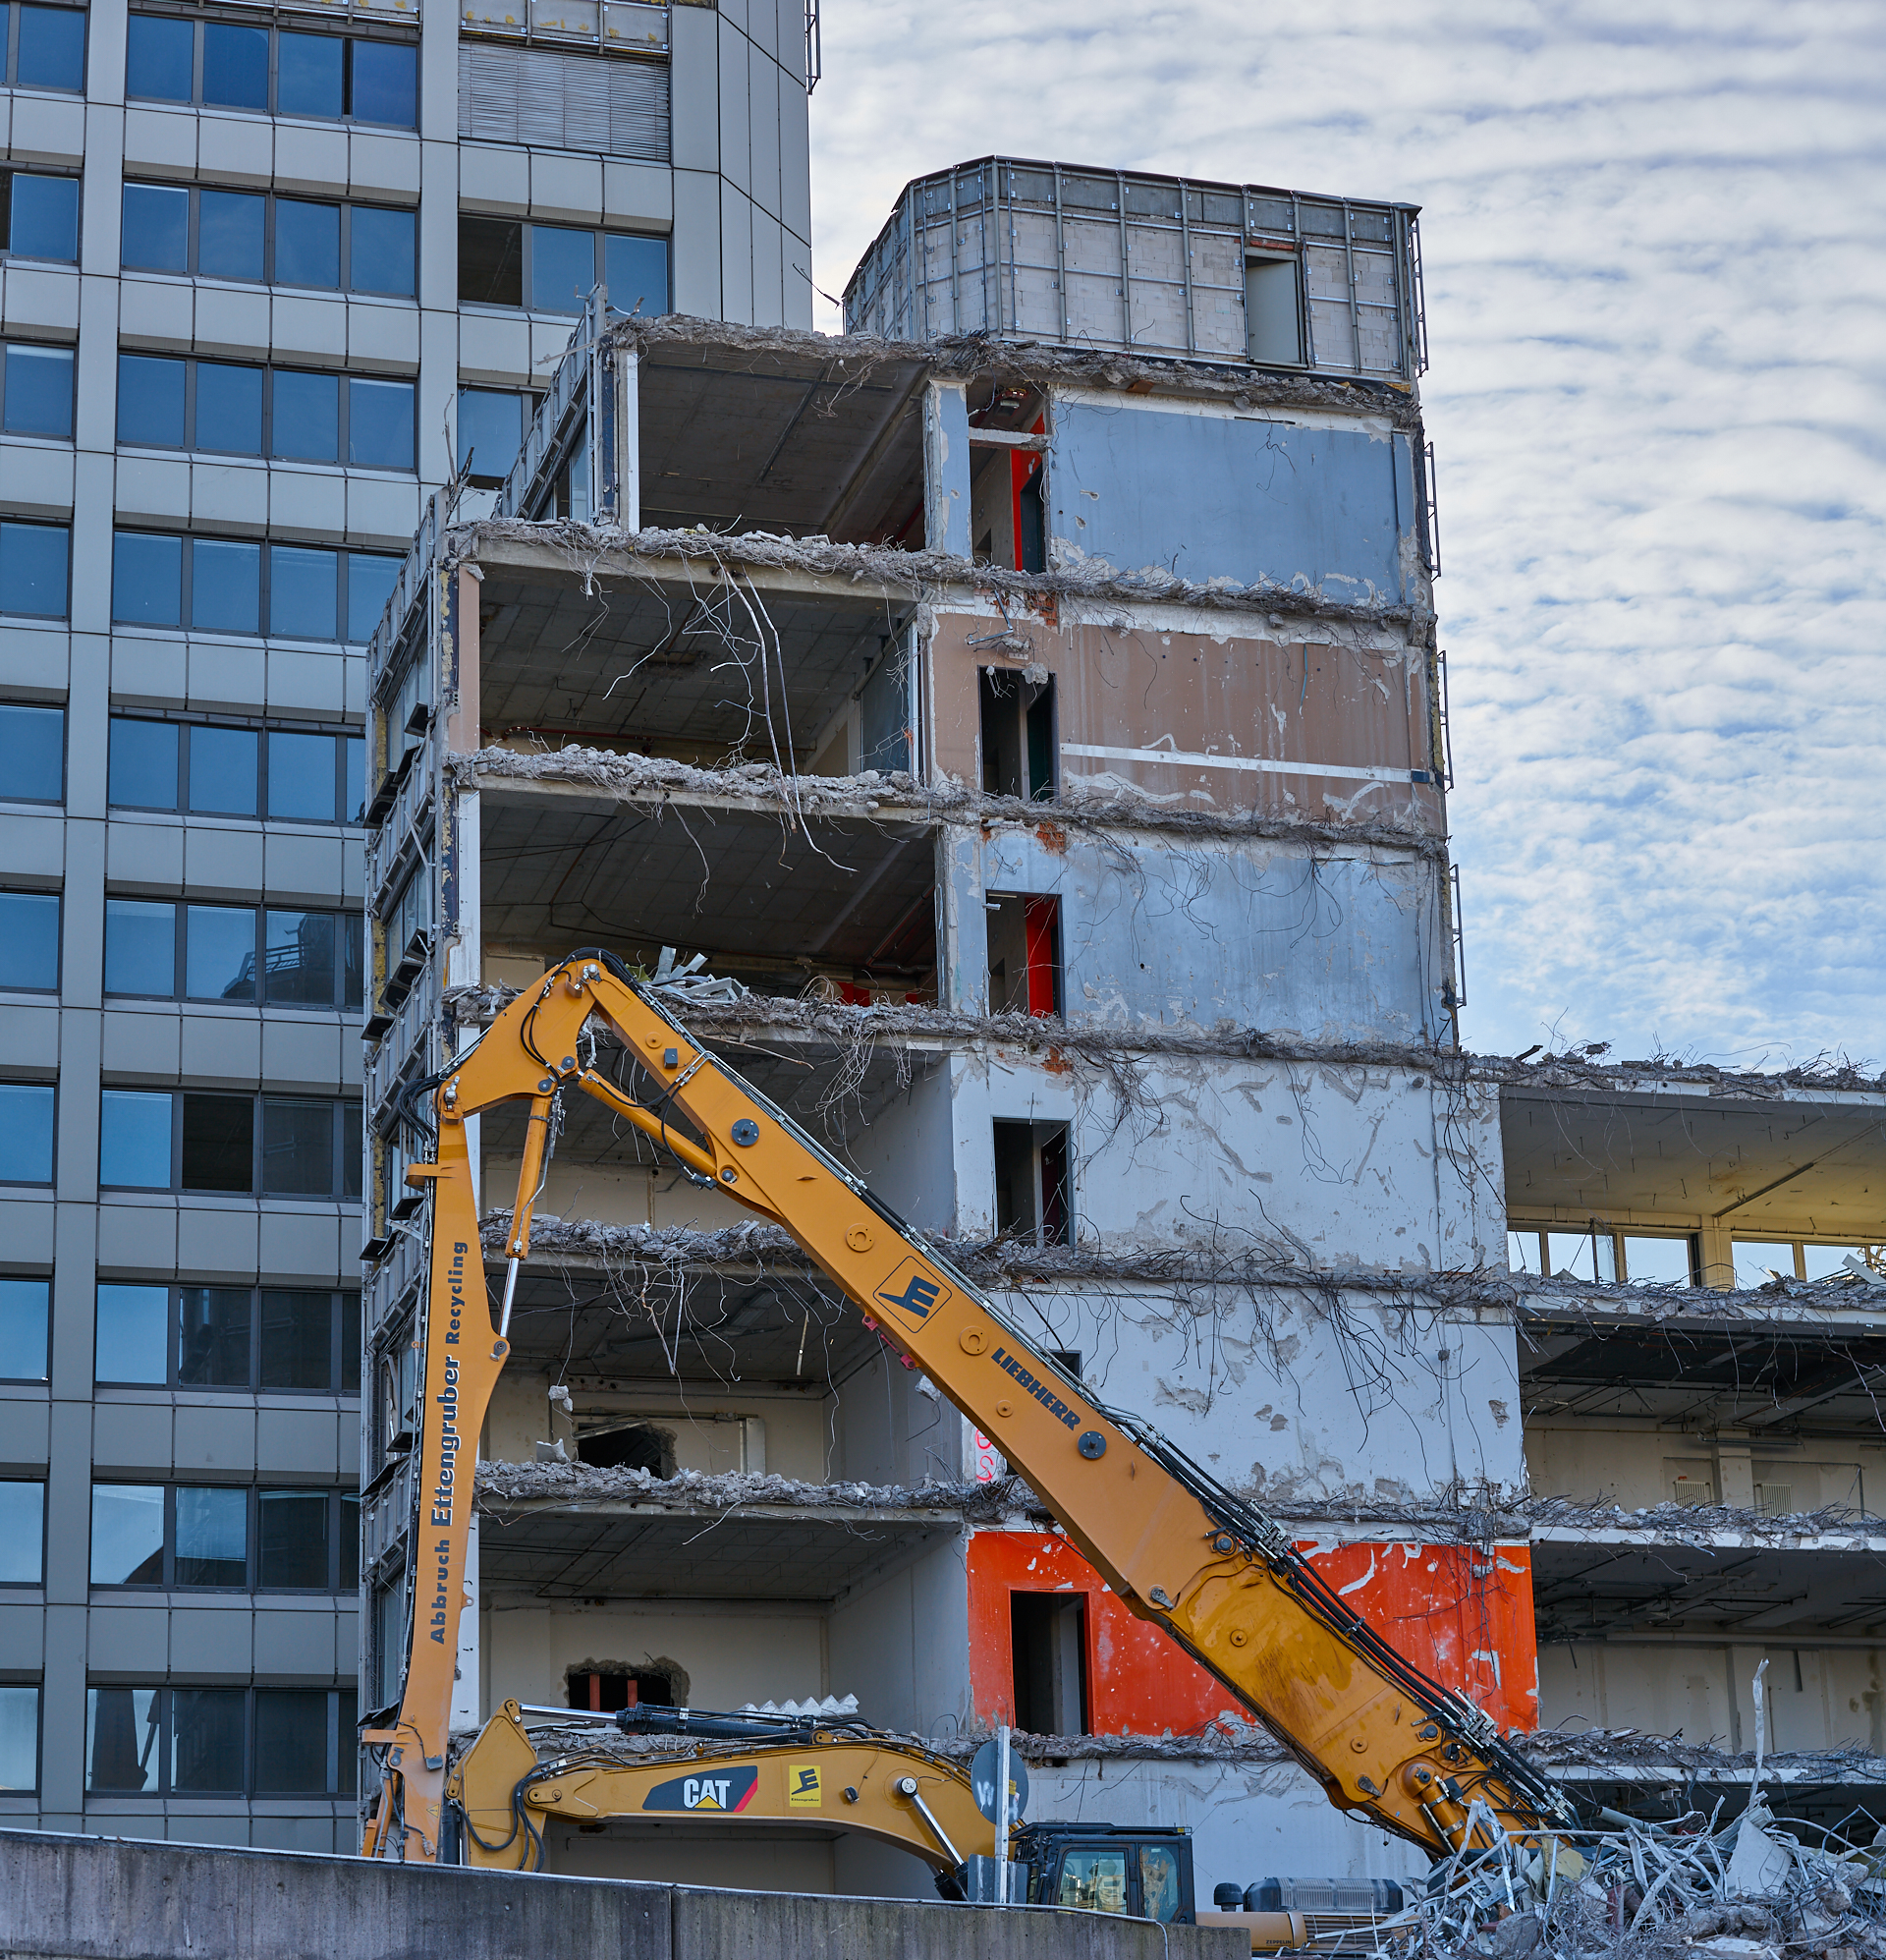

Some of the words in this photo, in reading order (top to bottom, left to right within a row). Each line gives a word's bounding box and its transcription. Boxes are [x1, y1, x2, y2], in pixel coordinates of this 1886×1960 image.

[445, 1241, 469, 1345] Recycling
[430, 1354, 462, 1527] Ettengruber
[990, 1347, 1082, 1431] LIEBHERR
[430, 1540, 450, 1645] Abbruch
[684, 1778, 732, 1810] CAT
